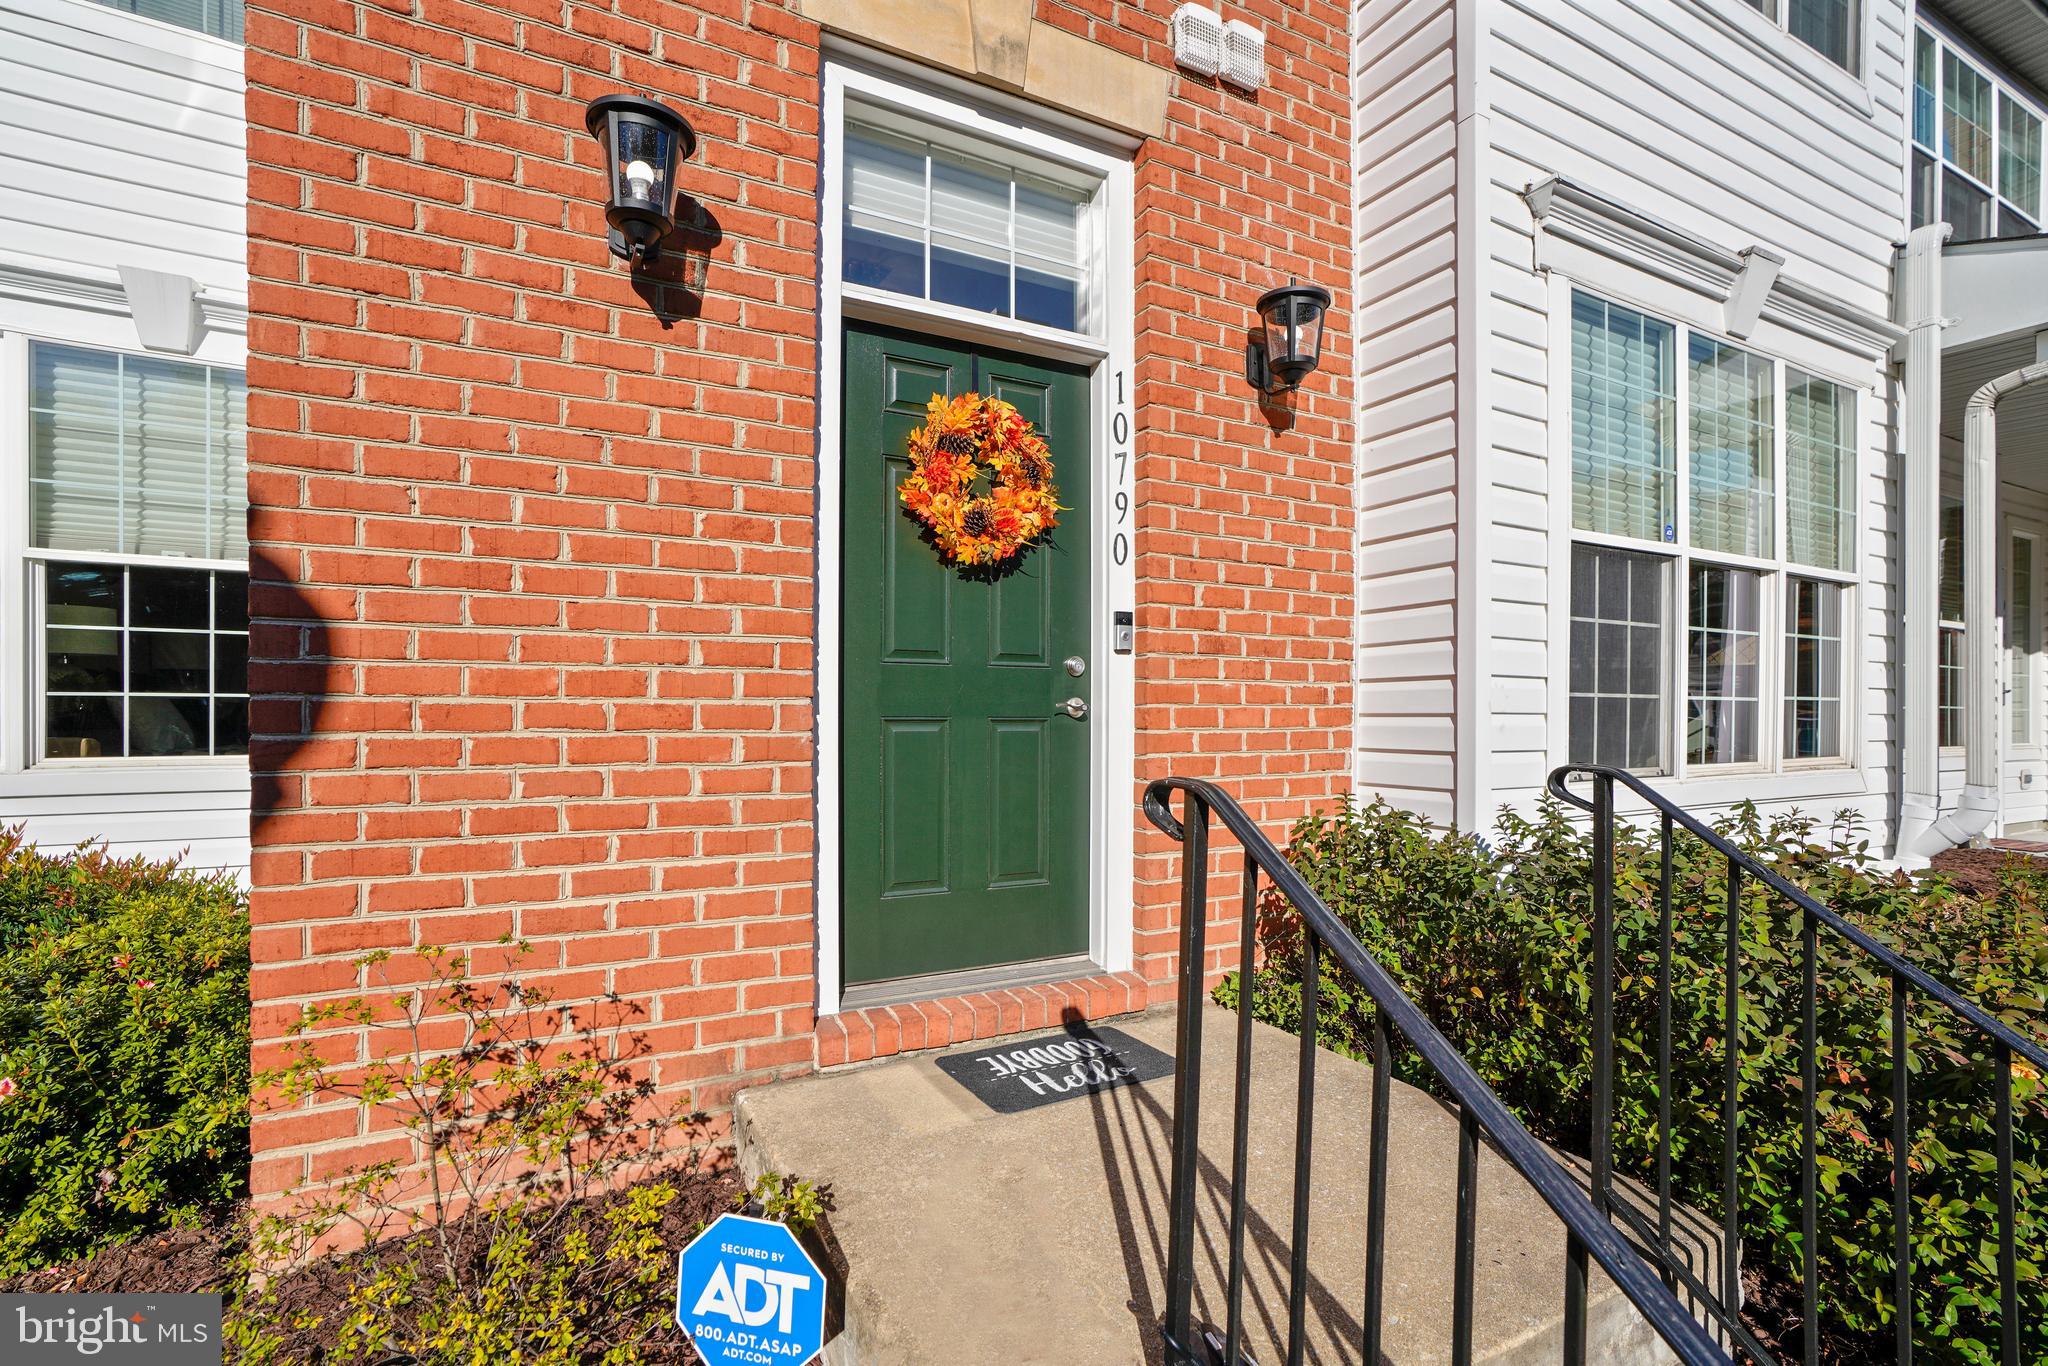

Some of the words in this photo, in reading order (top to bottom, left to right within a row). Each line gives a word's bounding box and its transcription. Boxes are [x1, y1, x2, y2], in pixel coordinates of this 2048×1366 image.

[1113, 370, 1128, 565] 10790
[975, 1038, 1112, 1077] GOODBYE
[1018, 1059, 1136, 1095] Hello
[720, 1242, 768, 1260] SECURED
[771, 1251, 785, 1263] BY
[691, 1260, 811, 1334] ADT
[694, 1323, 802, 1357] 800.ADT.ASAP
[722, 1346, 772, 1366] ADT.COM
